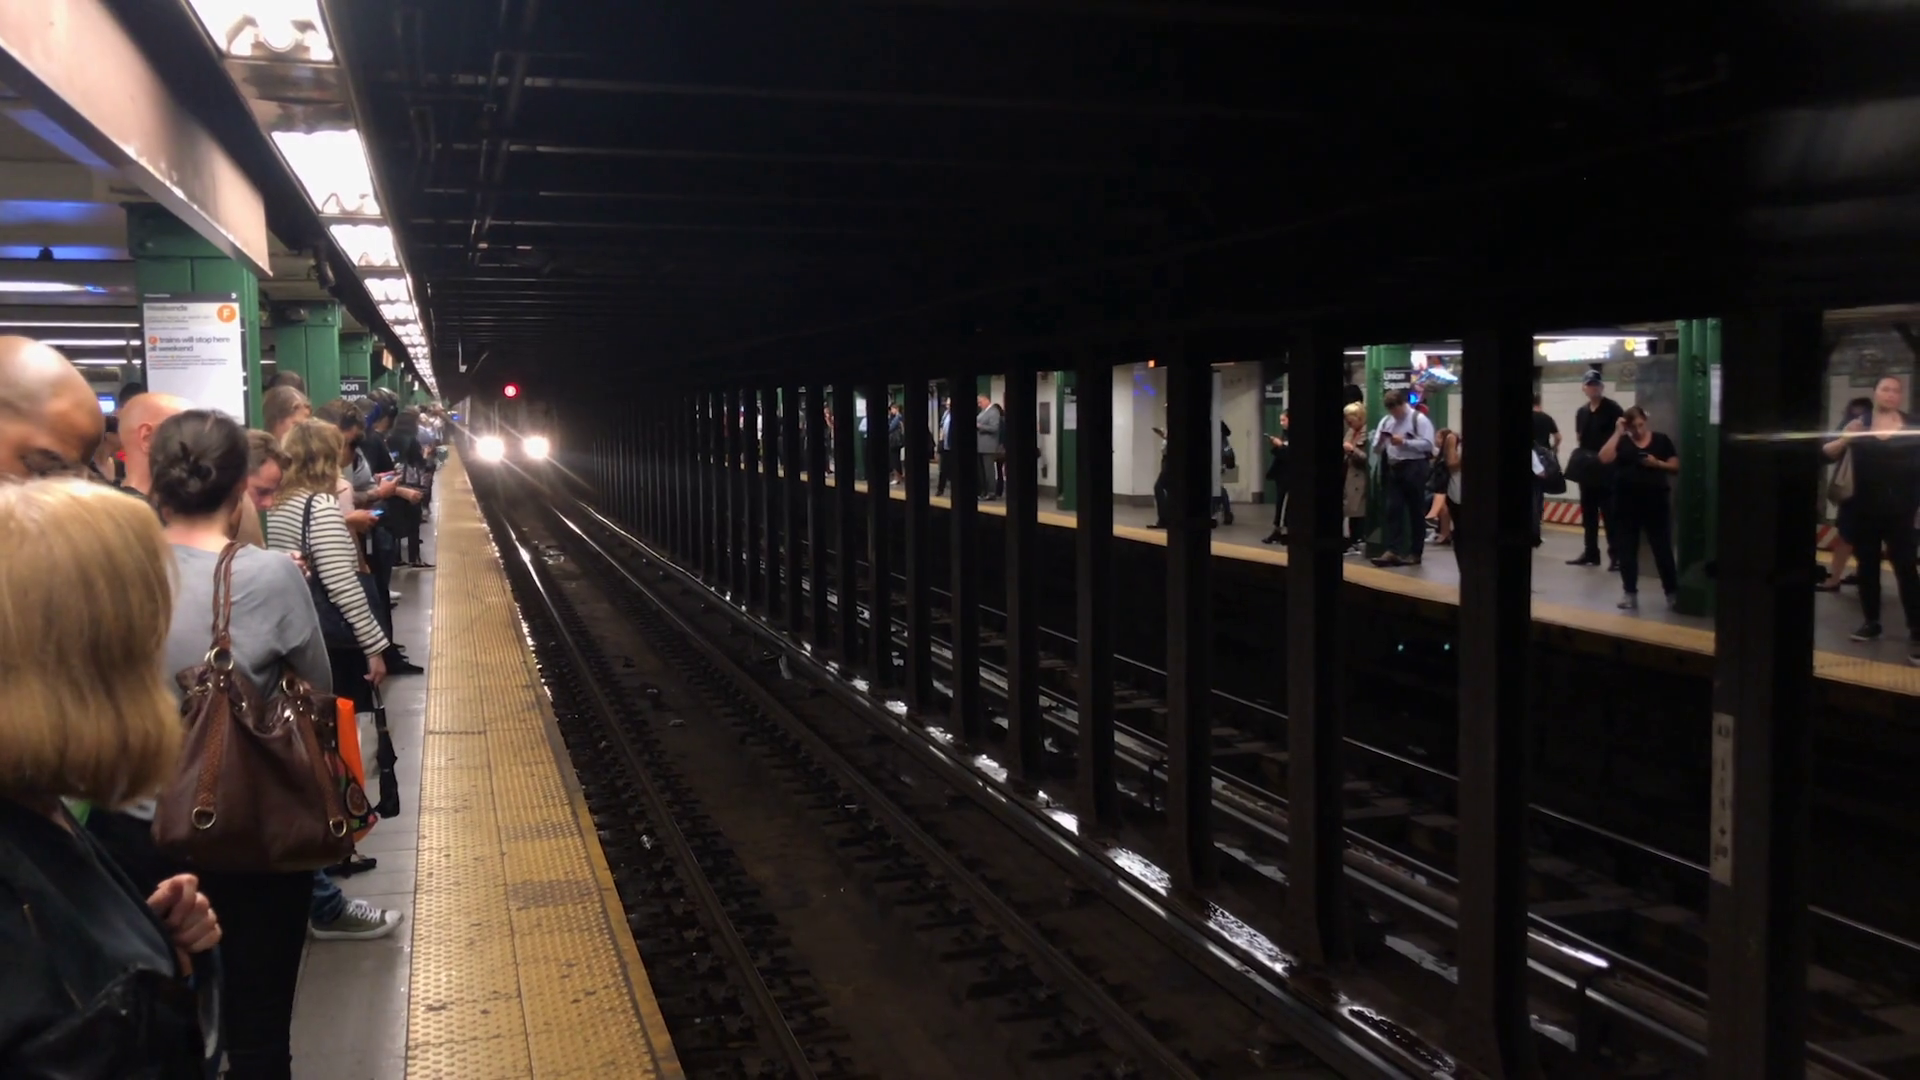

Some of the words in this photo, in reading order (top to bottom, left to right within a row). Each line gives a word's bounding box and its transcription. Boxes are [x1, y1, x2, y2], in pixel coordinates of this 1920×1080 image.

[159, 336, 181, 344] trains
[182, 336, 195, 344] will
[195, 336, 213, 345] stop
[213, 336, 231, 344] here
[158, 345, 194, 353] weekend
[1383, 372, 1405, 380] Union
